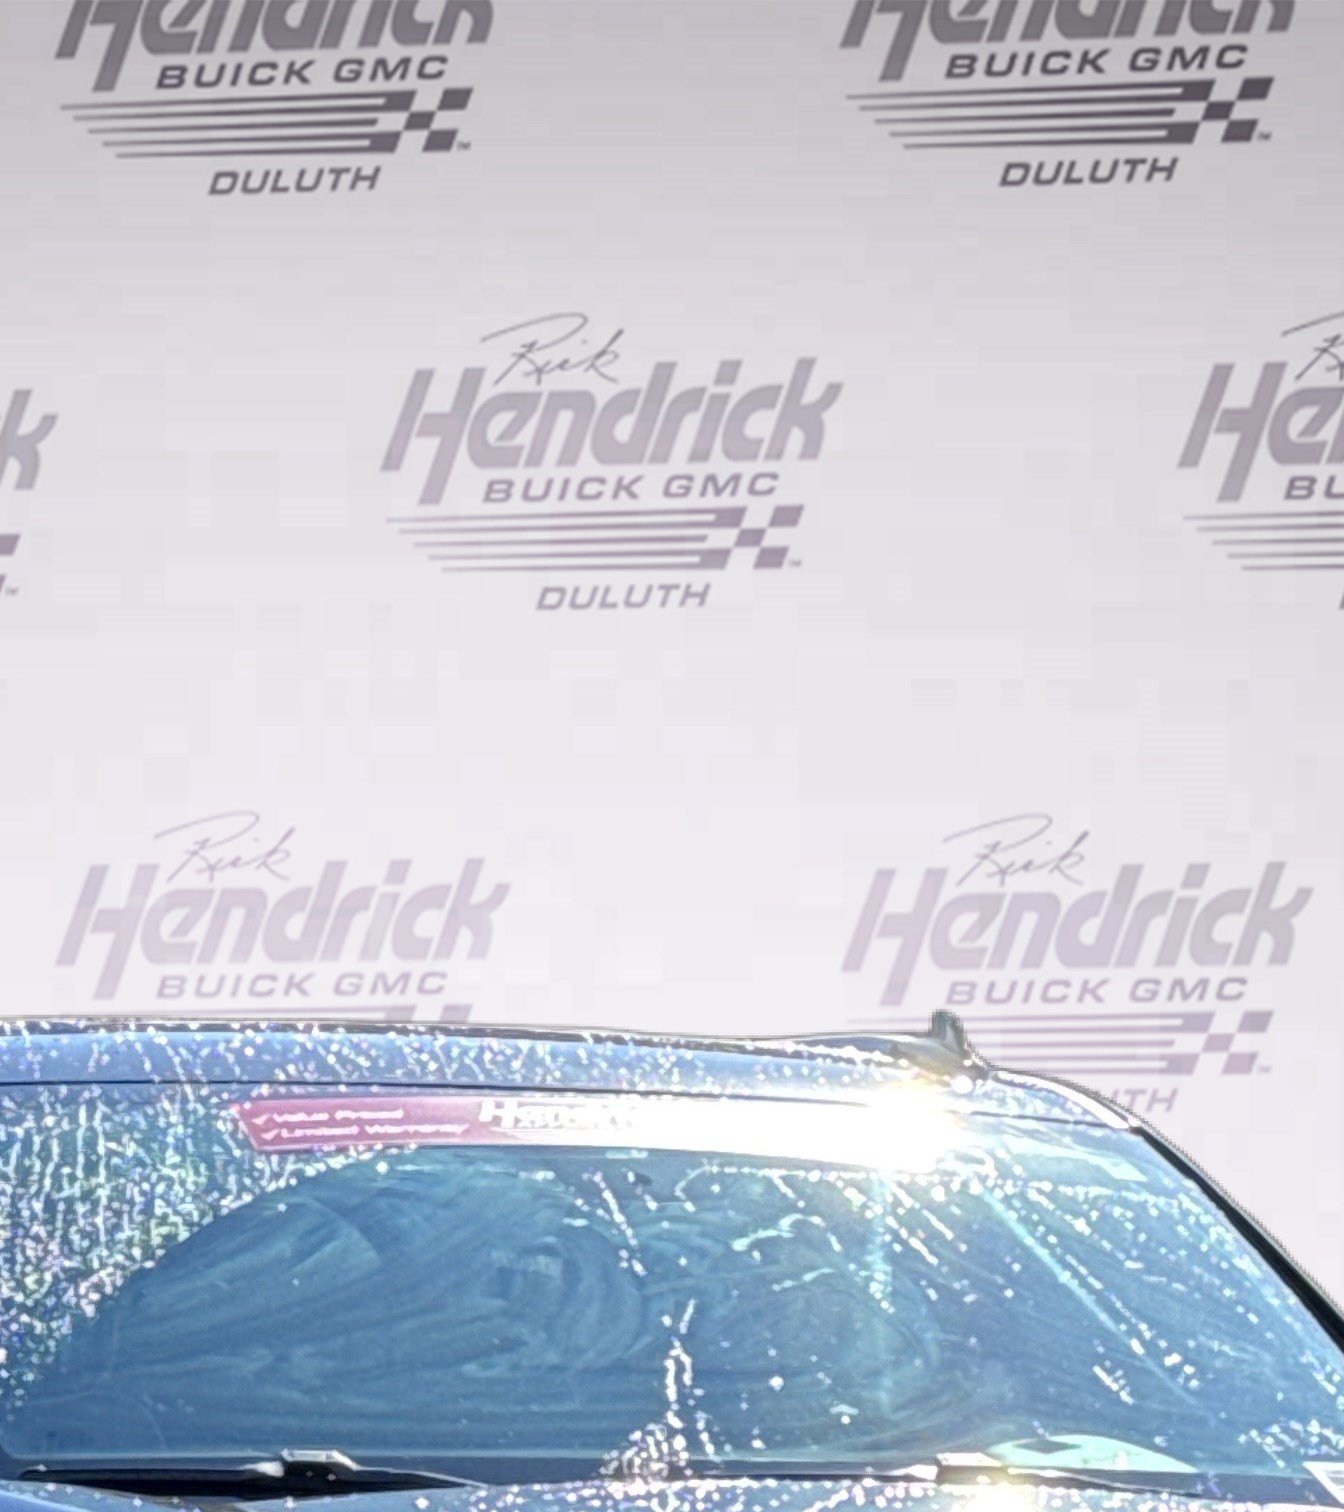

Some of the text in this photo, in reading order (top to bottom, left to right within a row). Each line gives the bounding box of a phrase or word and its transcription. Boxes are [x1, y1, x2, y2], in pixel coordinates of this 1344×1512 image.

[155, 56, 449, 89] BUICK GMC
[944, 45, 1249, 79] BUICK GMC
[208, 166, 382, 195] DULUTH
[998, 157, 1180, 187] DULUTH
[379, 357, 844, 506] Hendrick
[481, 472, 780, 503] BUICK GMC
[535, 583, 711, 612] DULUTH
[54, 857, 512, 1001] Hendrick
[840, 860, 1315, 1007] Hendrick
[155, 971, 449, 999] BUICK GMC
[944, 976, 1249, 1006] BUICK GMC
